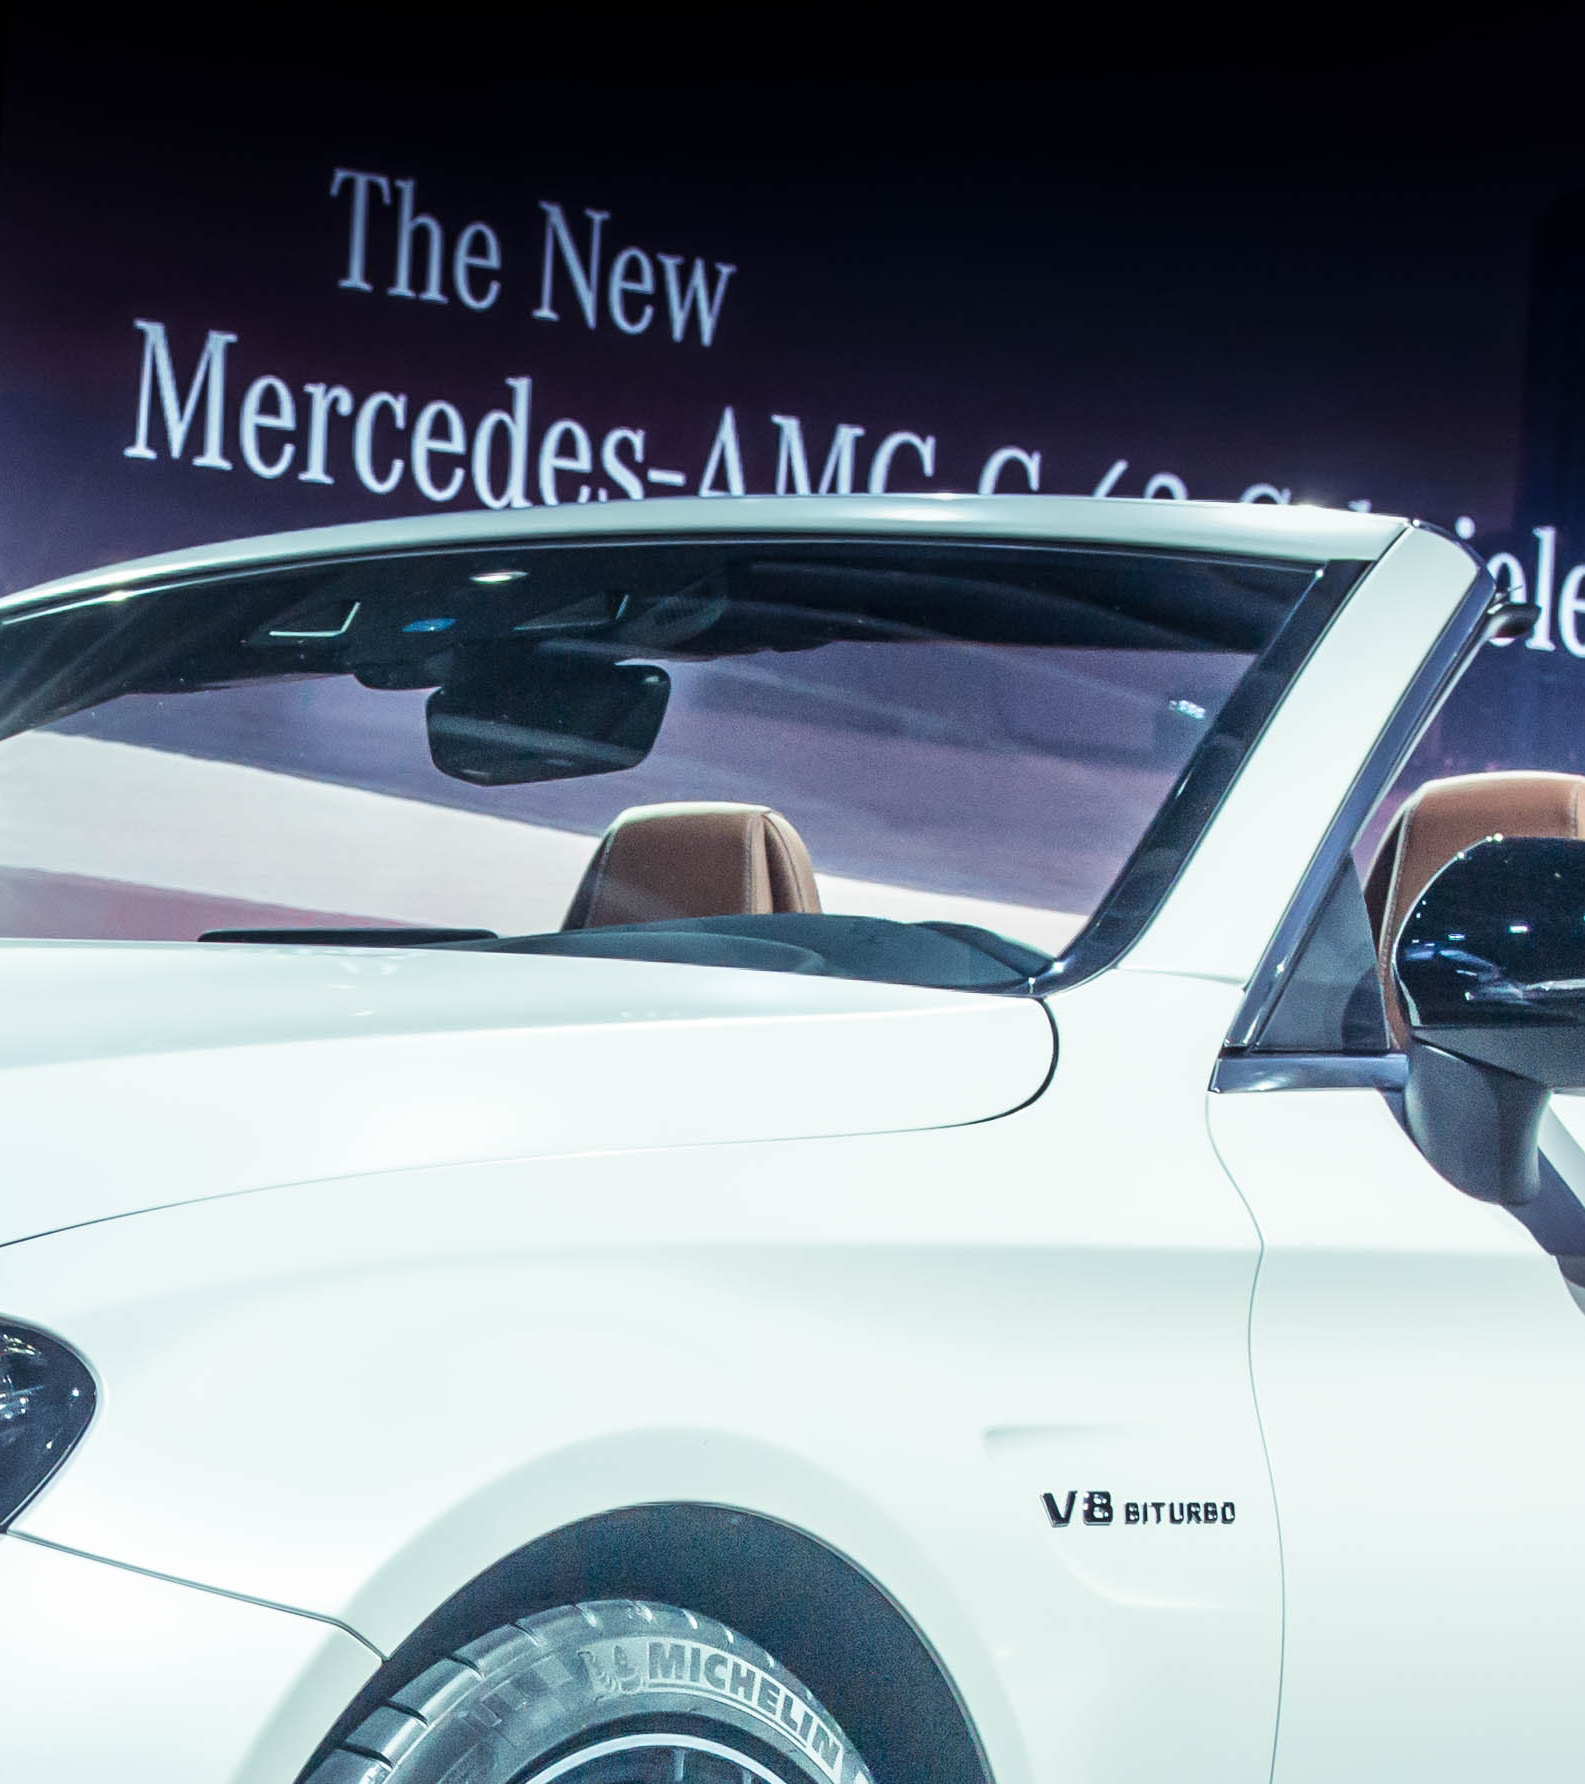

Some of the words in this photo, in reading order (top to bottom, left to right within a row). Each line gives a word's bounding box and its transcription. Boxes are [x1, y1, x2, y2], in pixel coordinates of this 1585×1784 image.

[331, 169, 501, 311] The
[532, 201, 737, 348] New
[1040, 1490, 1114, 1528] V8
[1124, 1501, 1236, 1525] BITURBO
[647, 1640, 842, 1775] MICHELIN
